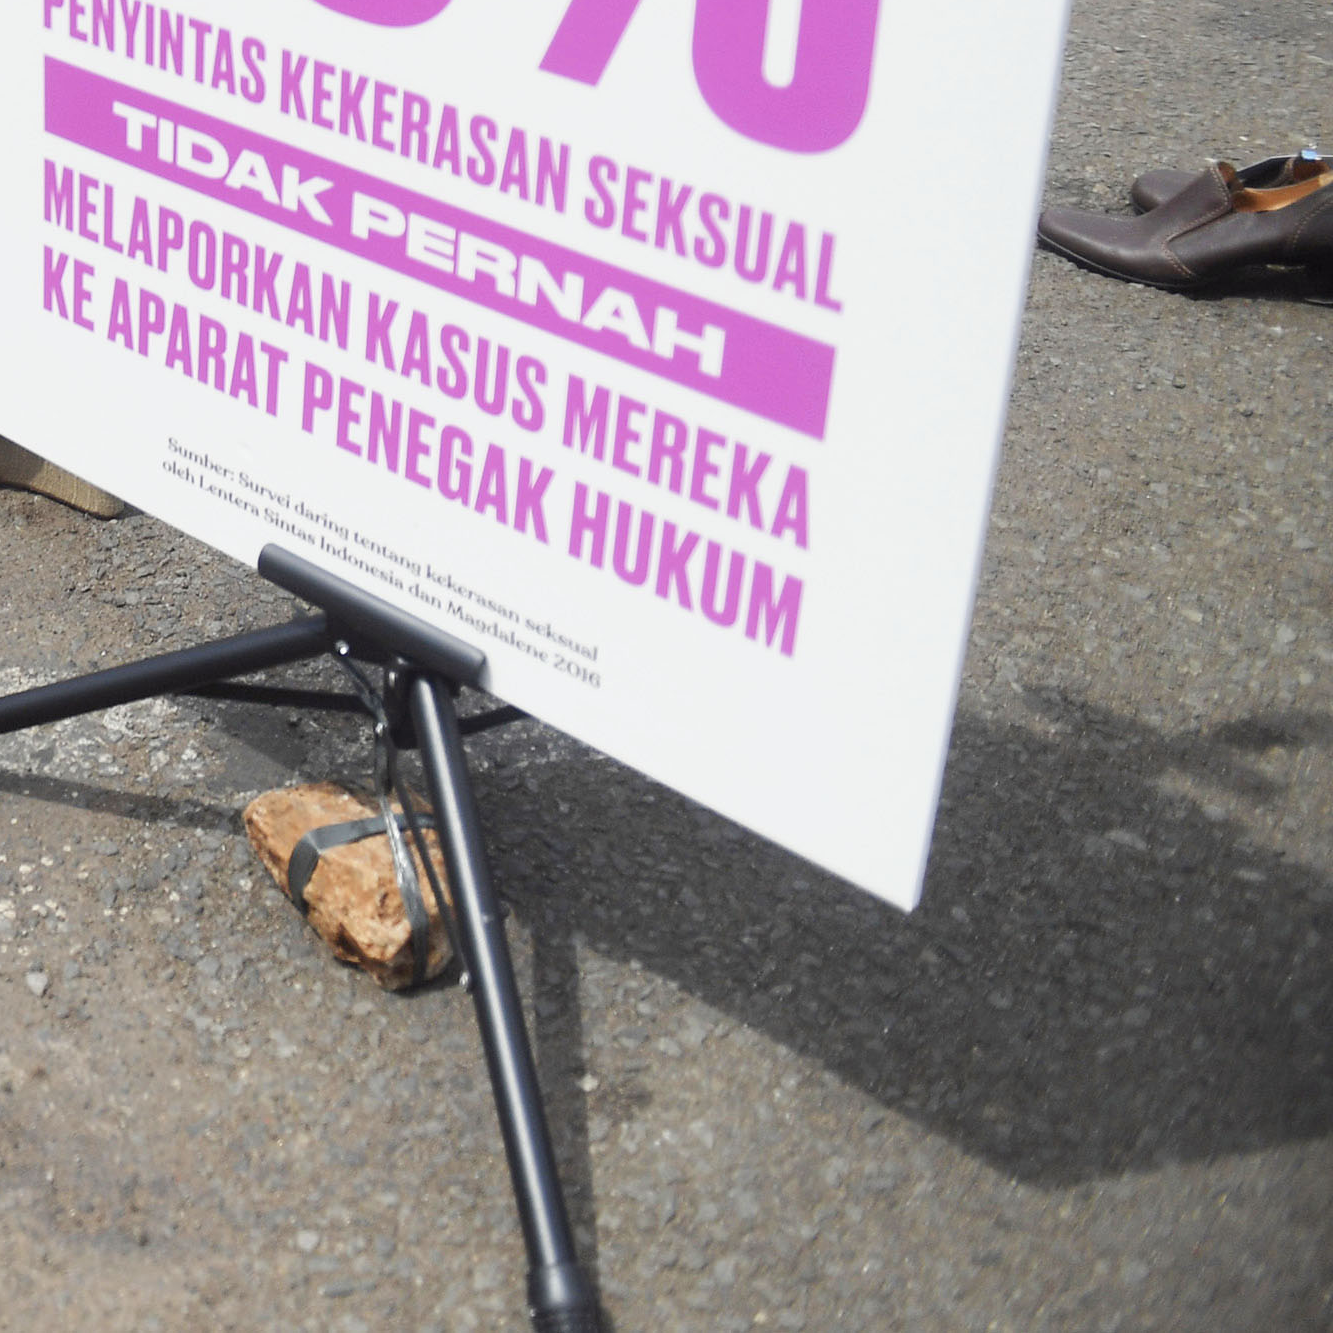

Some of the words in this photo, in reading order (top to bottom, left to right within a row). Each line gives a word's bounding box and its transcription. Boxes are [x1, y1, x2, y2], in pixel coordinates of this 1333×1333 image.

[113, 102, 334, 226] TIDAK
[350, 191, 726, 378] PERNAH
[281, 50, 569, 213] KEKERASAN
[585, 156, 841, 311] SEKSUAL
[44, 160, 350, 349] MELAPORKAN
[366, 293, 547, 432] KASUS
[563, 375, 808, 547] MEREKA
[44, 247, 94, 331] KE
[108, 278, 288, 415] APARAT
[302, 361, 553, 542] PENEGAK
[569, 483, 803, 655] HUKUM
[161, 460, 195, 485] oleh
[199, 474, 260, 517] Lentera
[263, 506, 316, 546] Sintas
[319, 535, 404, 590] Indonesia
[408, 583, 442, 610] dan
[446, 599, 550, 663] Magdalene
[552, 652, 602, 690] 2016
[167, 436, 235, 482] Sumber:
[238, 471, 291, 510] Survei
[294, 501, 349, 541] daring
[353, 531, 421, 577] tentang
[426, 563, 520, 624] kekerasan
[524, 618, 599, 662] seksual
